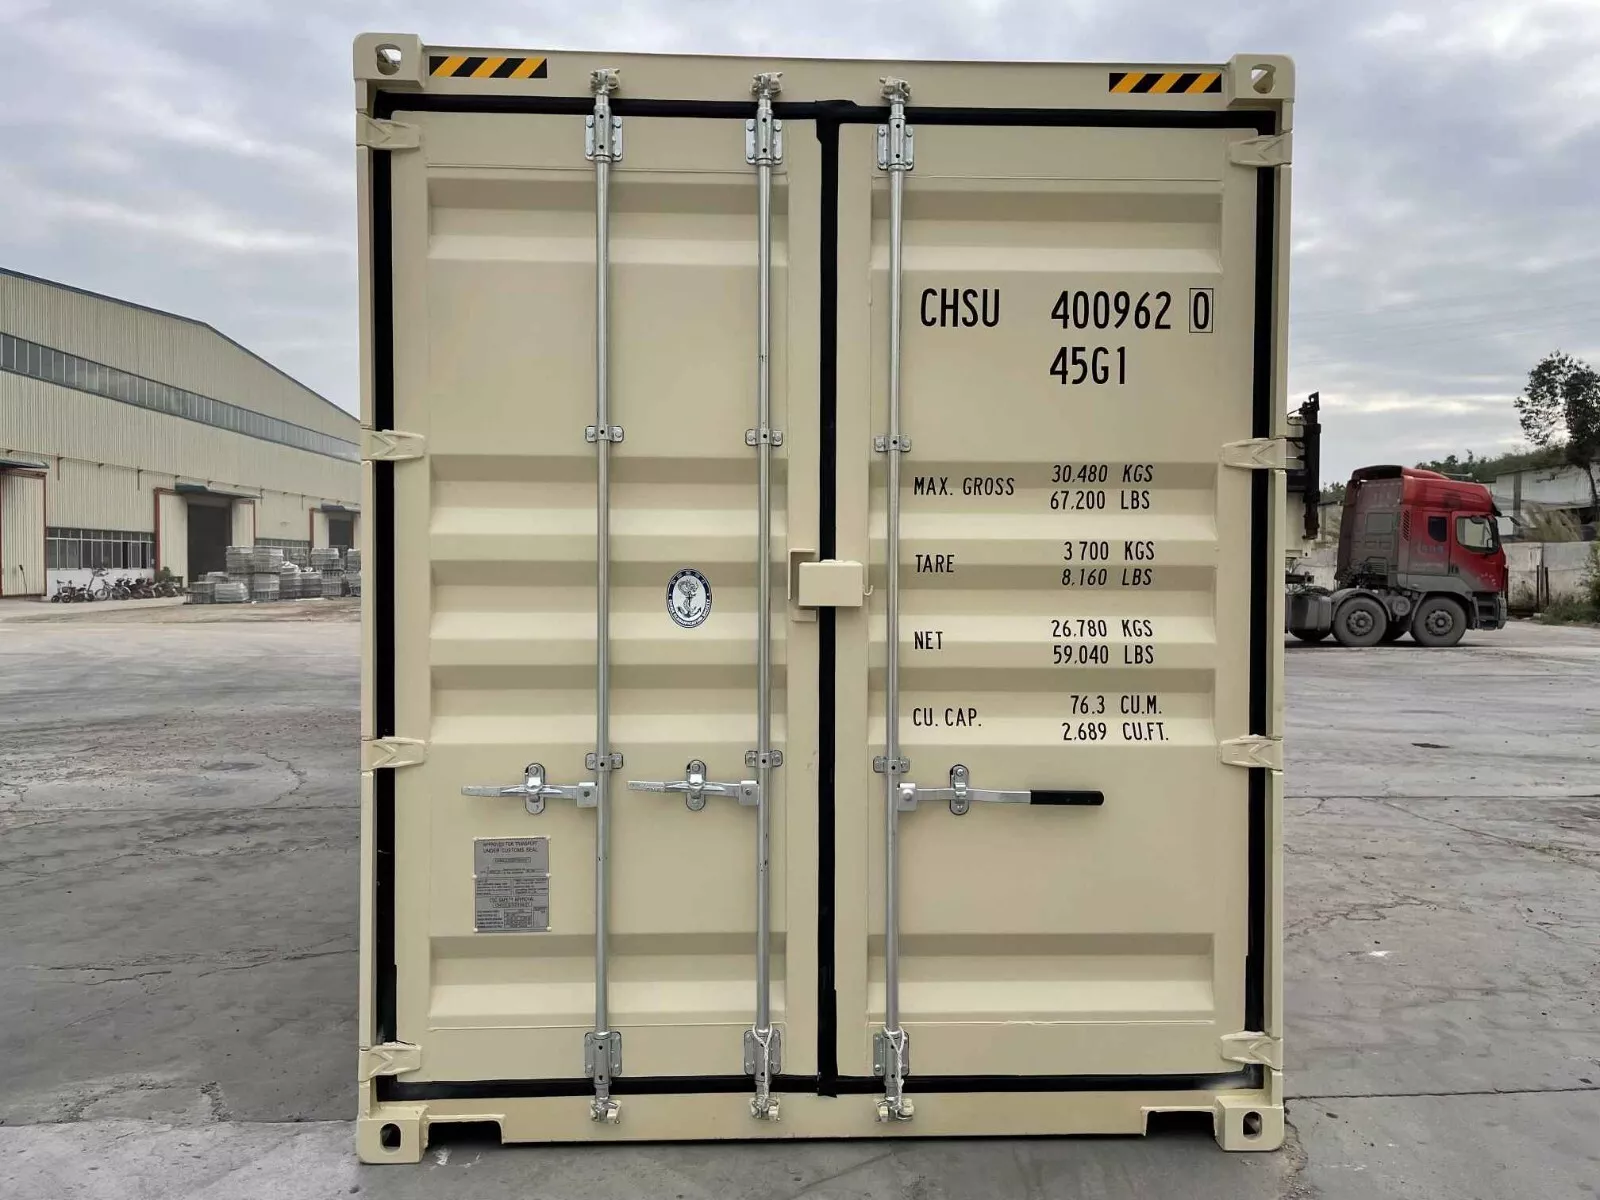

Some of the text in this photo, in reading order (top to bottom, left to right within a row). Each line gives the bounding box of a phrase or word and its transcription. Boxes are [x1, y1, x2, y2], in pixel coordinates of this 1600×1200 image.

[920, 287, 1210, 330] CHSU 400962 0
[1049, 345, 1127, 385] 45G1
[1122, 464, 1154, 483] KGS
[913, 477, 1015, 496] MAX. GROSS
[1120, 490, 1150, 510] LBS
[1124, 540, 1155, 561] KGS
[915, 554, 955, 573] TARE
[1121, 568, 1153, 586] LBS
[1121, 619, 1154, 638] KGS
[914, 631, 944, 650] NET
[1124, 645, 1154, 665] LBS
[1070, 695, 1162, 715] 76.3 CU.M.
[913, 707, 982, 727] CU. CAP.
[1122, 722, 1169, 741] CU.FT.
